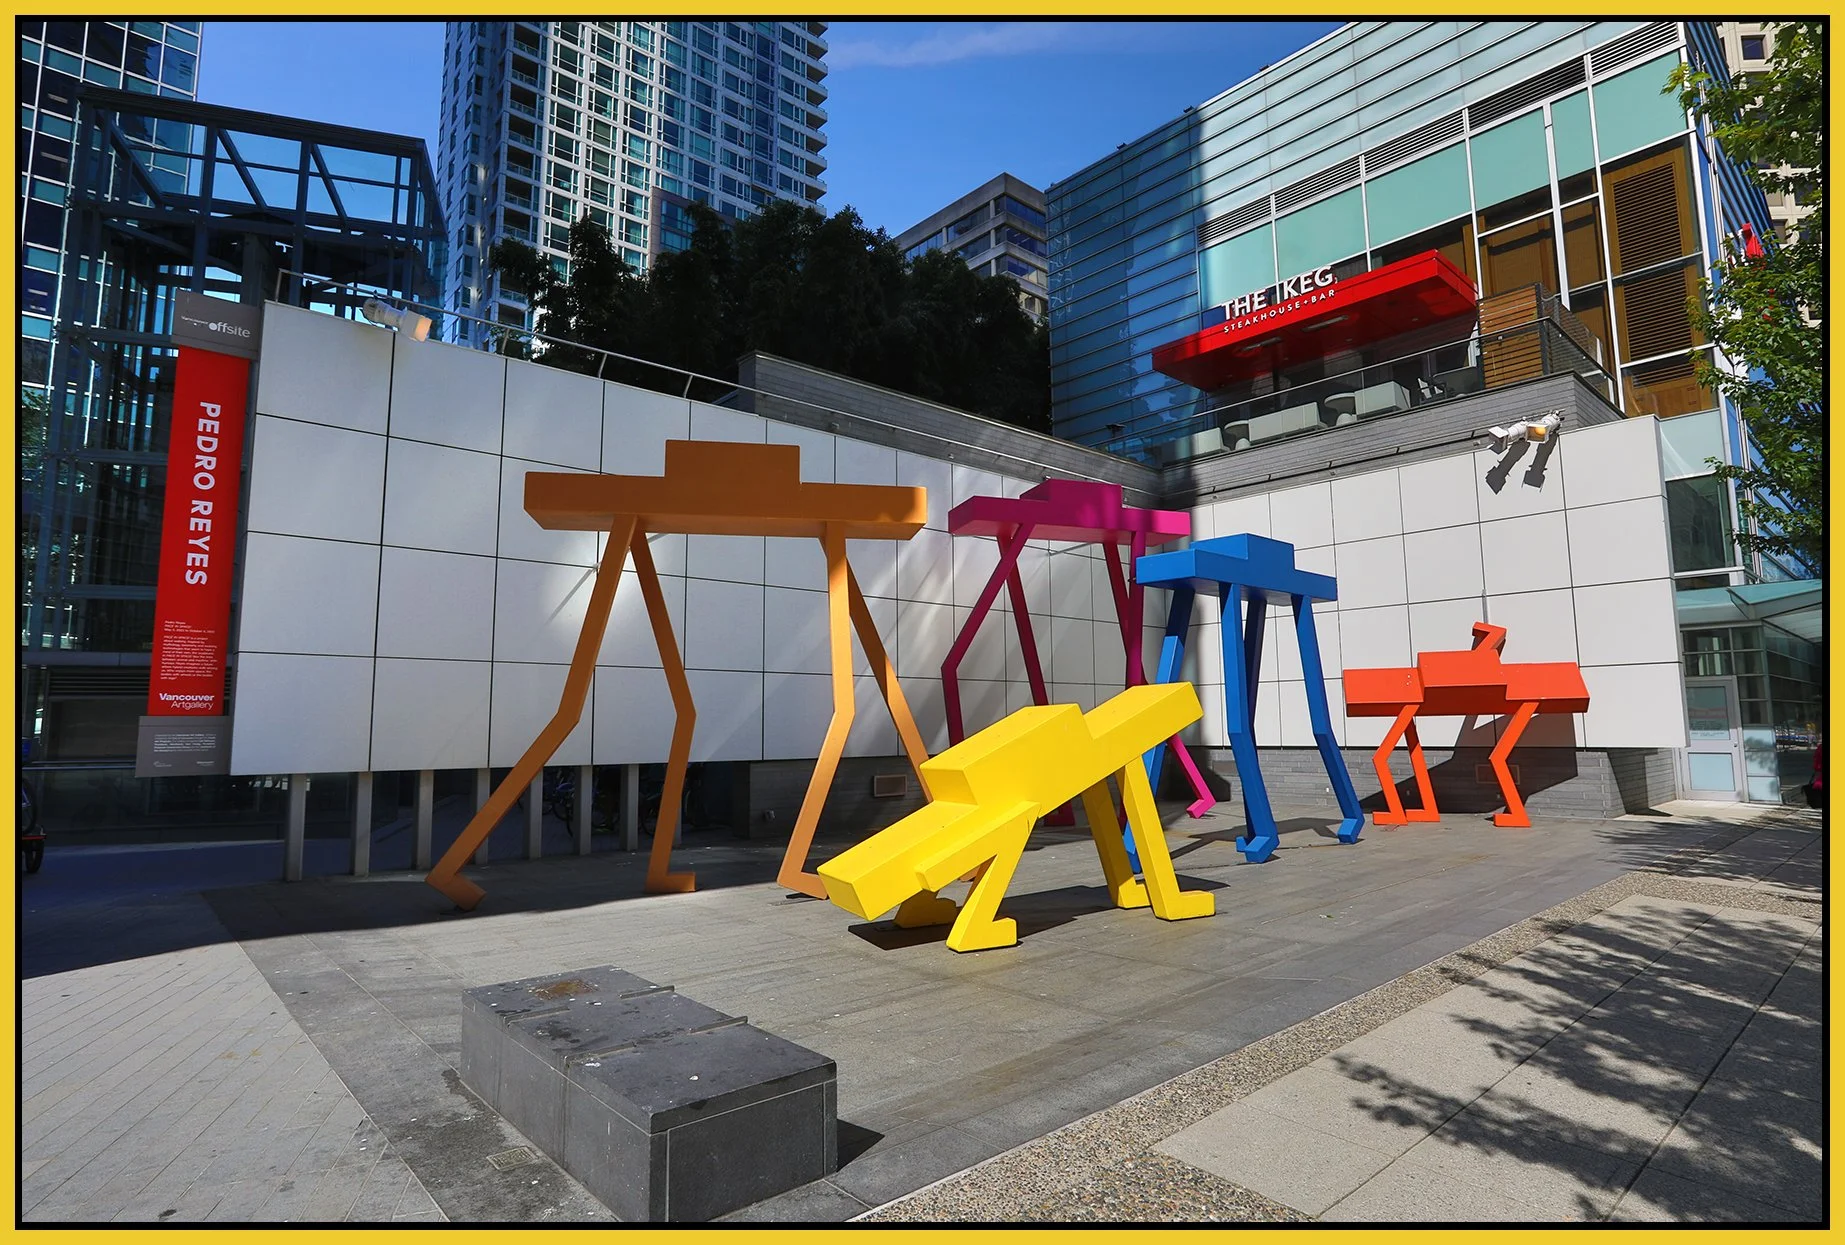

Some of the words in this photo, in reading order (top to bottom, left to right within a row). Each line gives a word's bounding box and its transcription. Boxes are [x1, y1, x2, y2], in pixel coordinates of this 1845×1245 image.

[1221, 289, 1267, 320] THE
[1282, 266, 1333, 300] KEG
[208, 321, 251, 338] offsite
[193, 401, 221, 490] PEDRO
[185, 500, 213, 585] REYES
[159, 692, 215, 702] Vancouver
[170, 700, 214, 710] Artgallery
